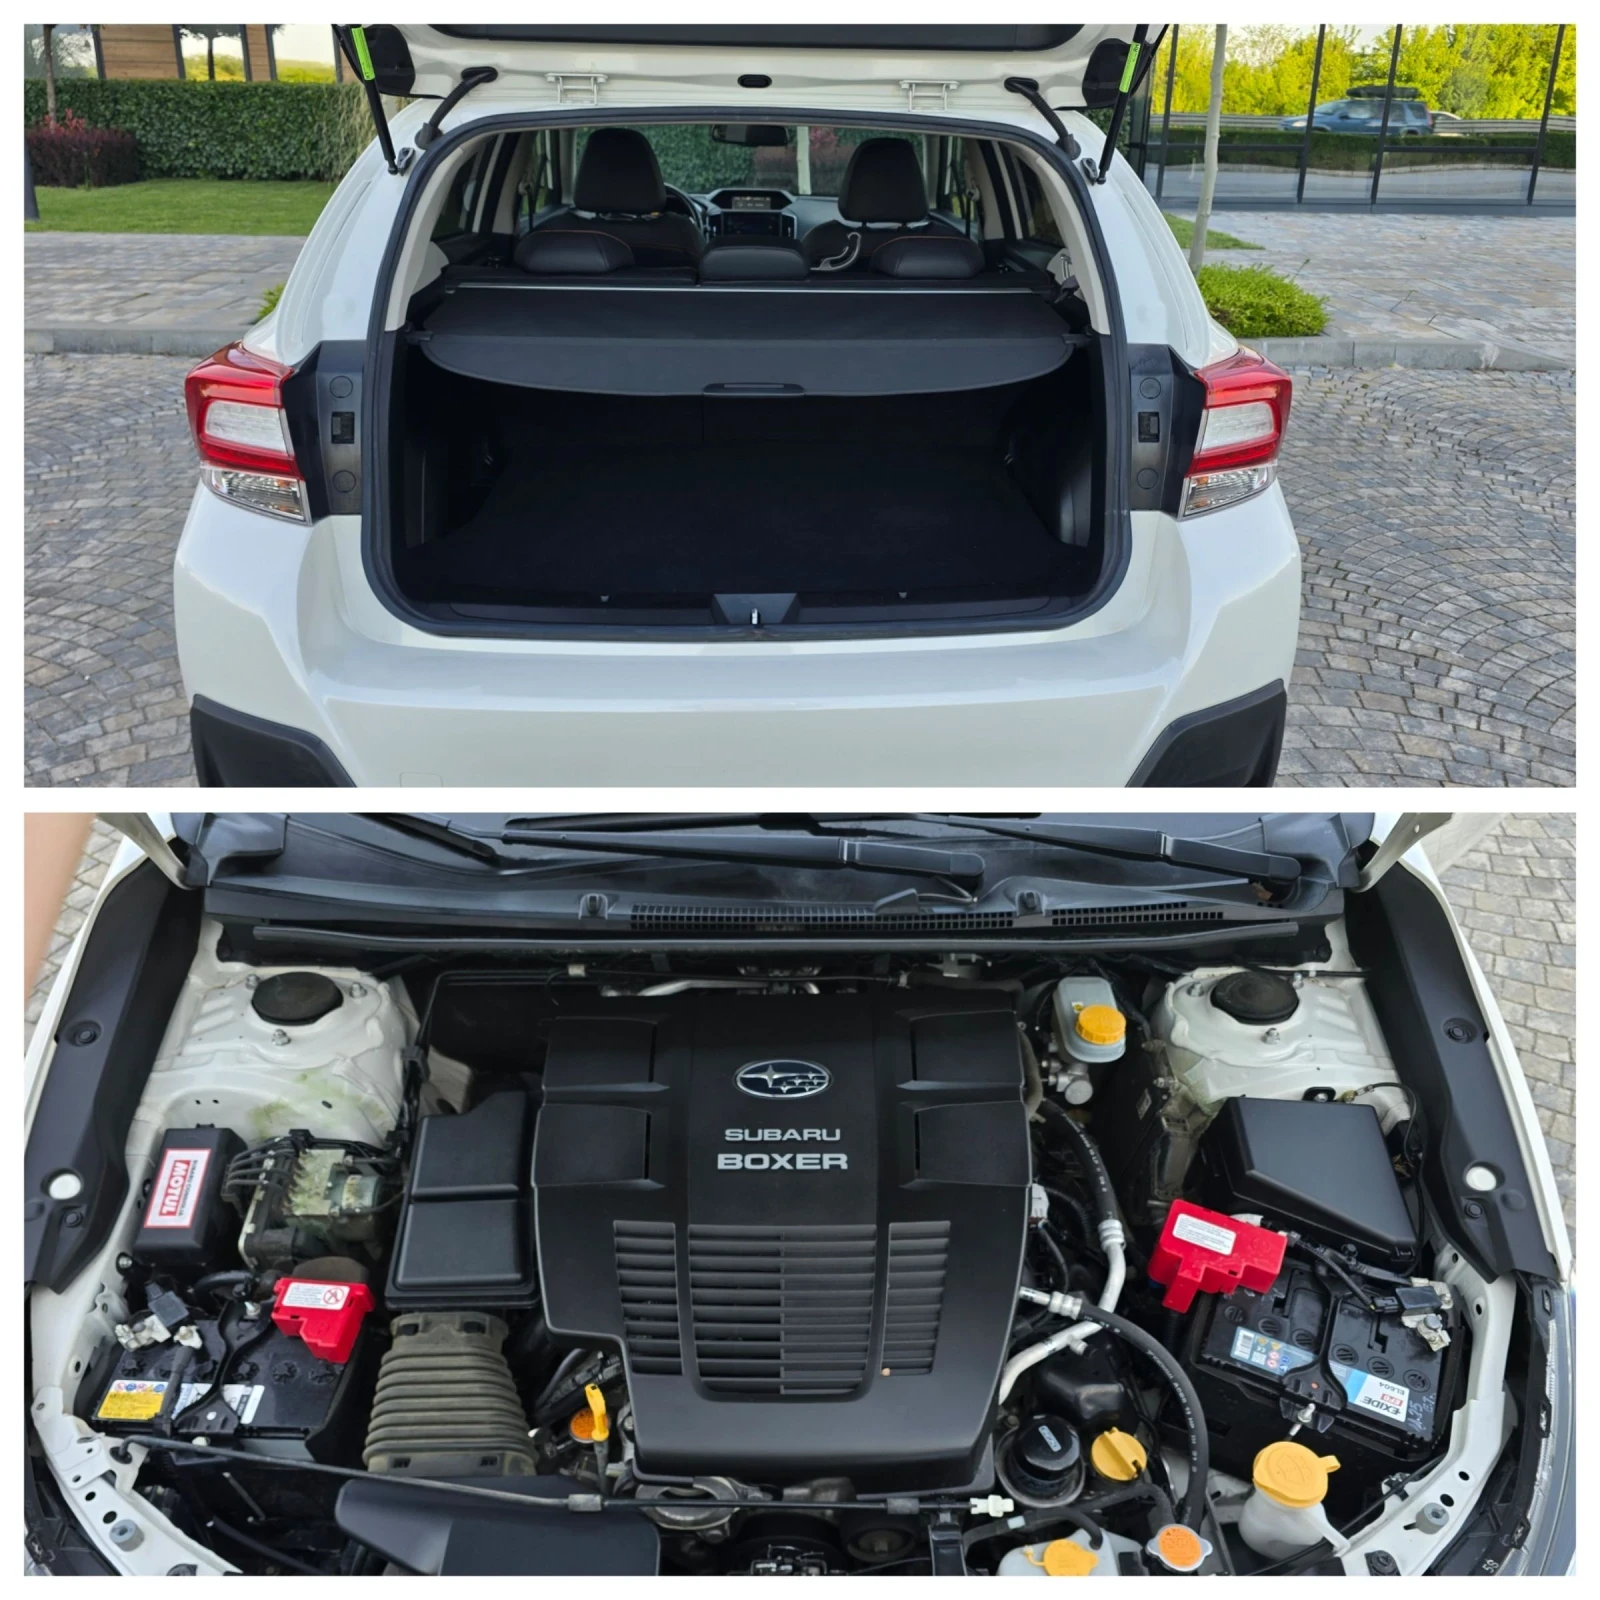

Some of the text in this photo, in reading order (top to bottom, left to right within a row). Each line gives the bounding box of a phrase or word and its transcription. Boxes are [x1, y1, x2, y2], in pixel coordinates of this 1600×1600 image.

[724, 1128, 841, 1141] SUBARU
[717, 1153, 848, 1170] BOXER
[161, 1161, 189, 1214] MOTUL
[1363, 1396, 1401, 1415] EXIDE
